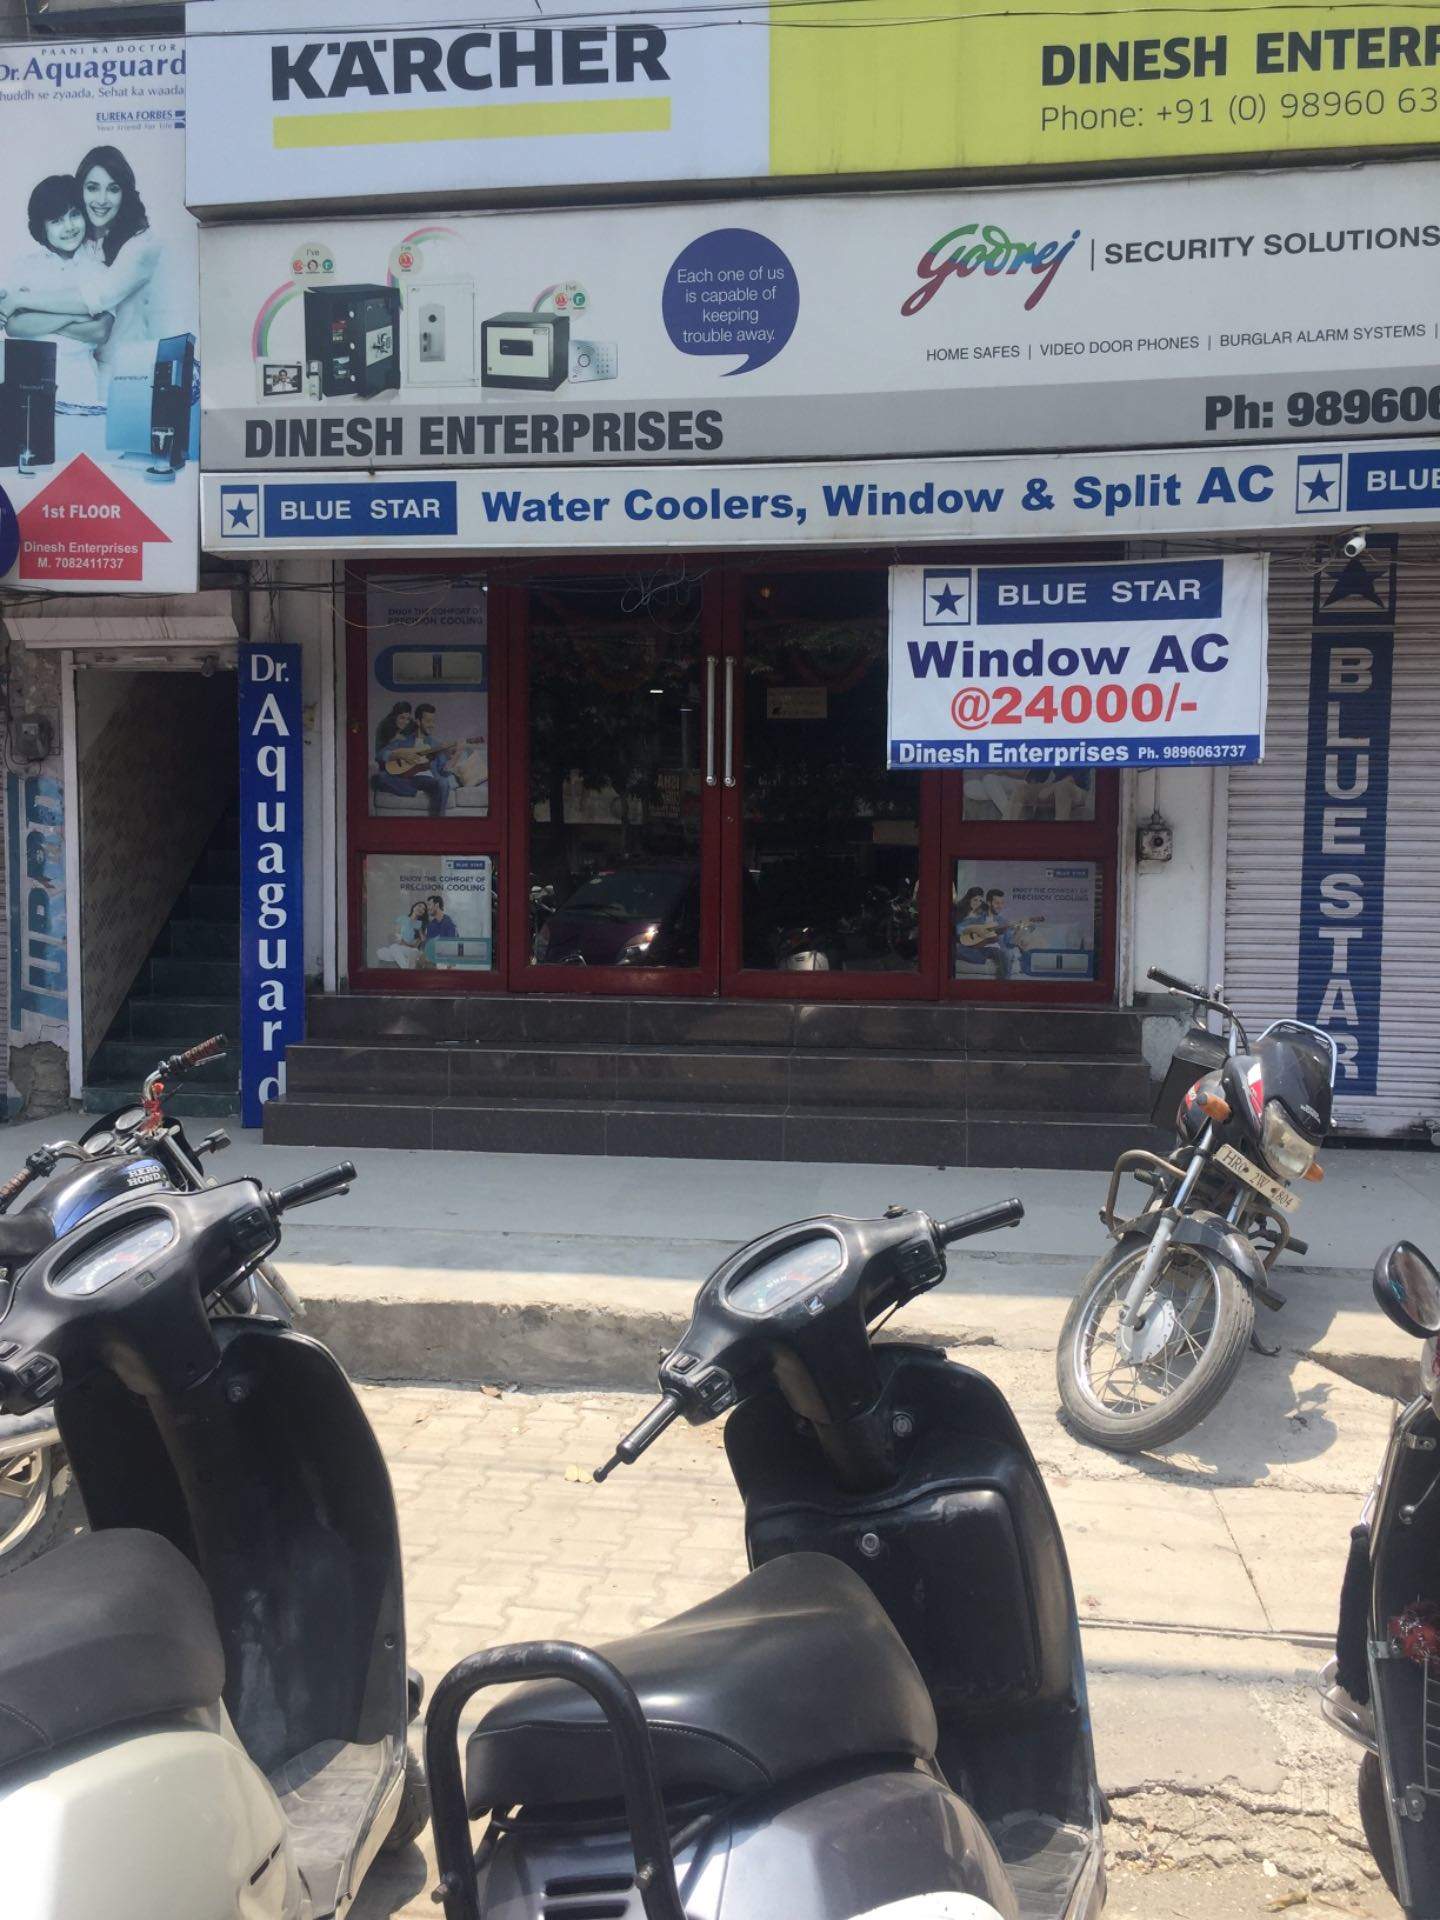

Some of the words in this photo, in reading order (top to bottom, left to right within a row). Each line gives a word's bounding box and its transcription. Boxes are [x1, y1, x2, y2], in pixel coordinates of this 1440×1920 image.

[41, 47, 84, 56] PAANI
[93, 46, 108, 54] KA
[117, 43, 176, 53] DOCTOR
[271, 24, 671, 101] KÄRCHER
[1041, 34, 1228, 87] DINESH
[23, 50, 186, 87] Aquaguard
[98, 86, 129, 98] Sehat
[131, 86, 144, 97] ka
[147, 84, 184, 97] waada
[96, 111, 134, 121] EUREKA
[136, 110, 173, 120] FORBES
[1041, 104, 1143, 132] Phone:
[1157, 97, 1213, 124] +91
[1228, 94, 1266, 125] (0)
[1281, 89, 1385, 119] 98960
[1398, 87, 1438, 114] 63
[677, 268, 713, 283] Each
[717, 269, 745, 282] one
[749, 265, 764, 281] of
[767, 267, 785, 280] us
[900, 223, 1081, 316] Godrej
[1104, 235, 1255, 265] SECURITY
[1263, 225, 1440, 256] SOLUTIONS
[685, 289, 697, 303] is
[701, 287, 758, 305] capable
[762, 286, 777, 301] of
[703, 307, 759, 324] keeping
[683, 328, 733, 343] trouble
[736, 329, 775, 343] away.
[926, 348, 969, 361] HOME
[973, 345, 1020, 359] SAFES
[1040, 342, 1086, 356] VIDEO
[1089, 339, 1133, 354] DOOR
[1137, 335, 1200, 351] PHONES
[1220, 331, 1293, 347] BURGLAR
[1296, 328, 1349, 343] ALARM
[1353, 324, 1427, 341] SYSTEMS
[1205, 394, 1274, 431] Ph:
[245, 416, 403, 458] DINESH
[419, 409, 724, 456] ENTERPRISES
[42, 504, 65, 519] 1st
[70, 504, 121, 519] FLOOR
[280, 500, 352, 521] BLUE
[370, 498, 441, 519] STAR
[481, 491, 610, 522] Water
[624, 487, 807, 526] Coolers,
[822, 482, 1005, 517] Window
[1021, 478, 1056, 512] &
[1073, 473, 1181, 517] Split
[1196, 464, 1274, 504] AC
[24, 541, 65, 553] Dinesh
[69, 541, 138, 556] Enterprises
[37, 557, 52, 568] M.
[55, 557, 124, 569] 7082411737
[998, 582, 1087, 606] BLUE
[1111, 579, 1201, 603] STAR
[251, 653, 290, 682] Dr.
[907, 638, 1131, 679] Window
[1148, 633, 1229, 674] AC
[951, 682, 1197, 731] @24000/-
[899, 742, 980, 764] Dinesh
[988, 741, 1129, 766] Enterprises
[1138, 747, 1159, 760] Ph.
[1162, 745, 1247, 760] 9896063737
[1321, 647, 1375, 855] BLUE
[251, 693, 290, 1105] Aquaguard
